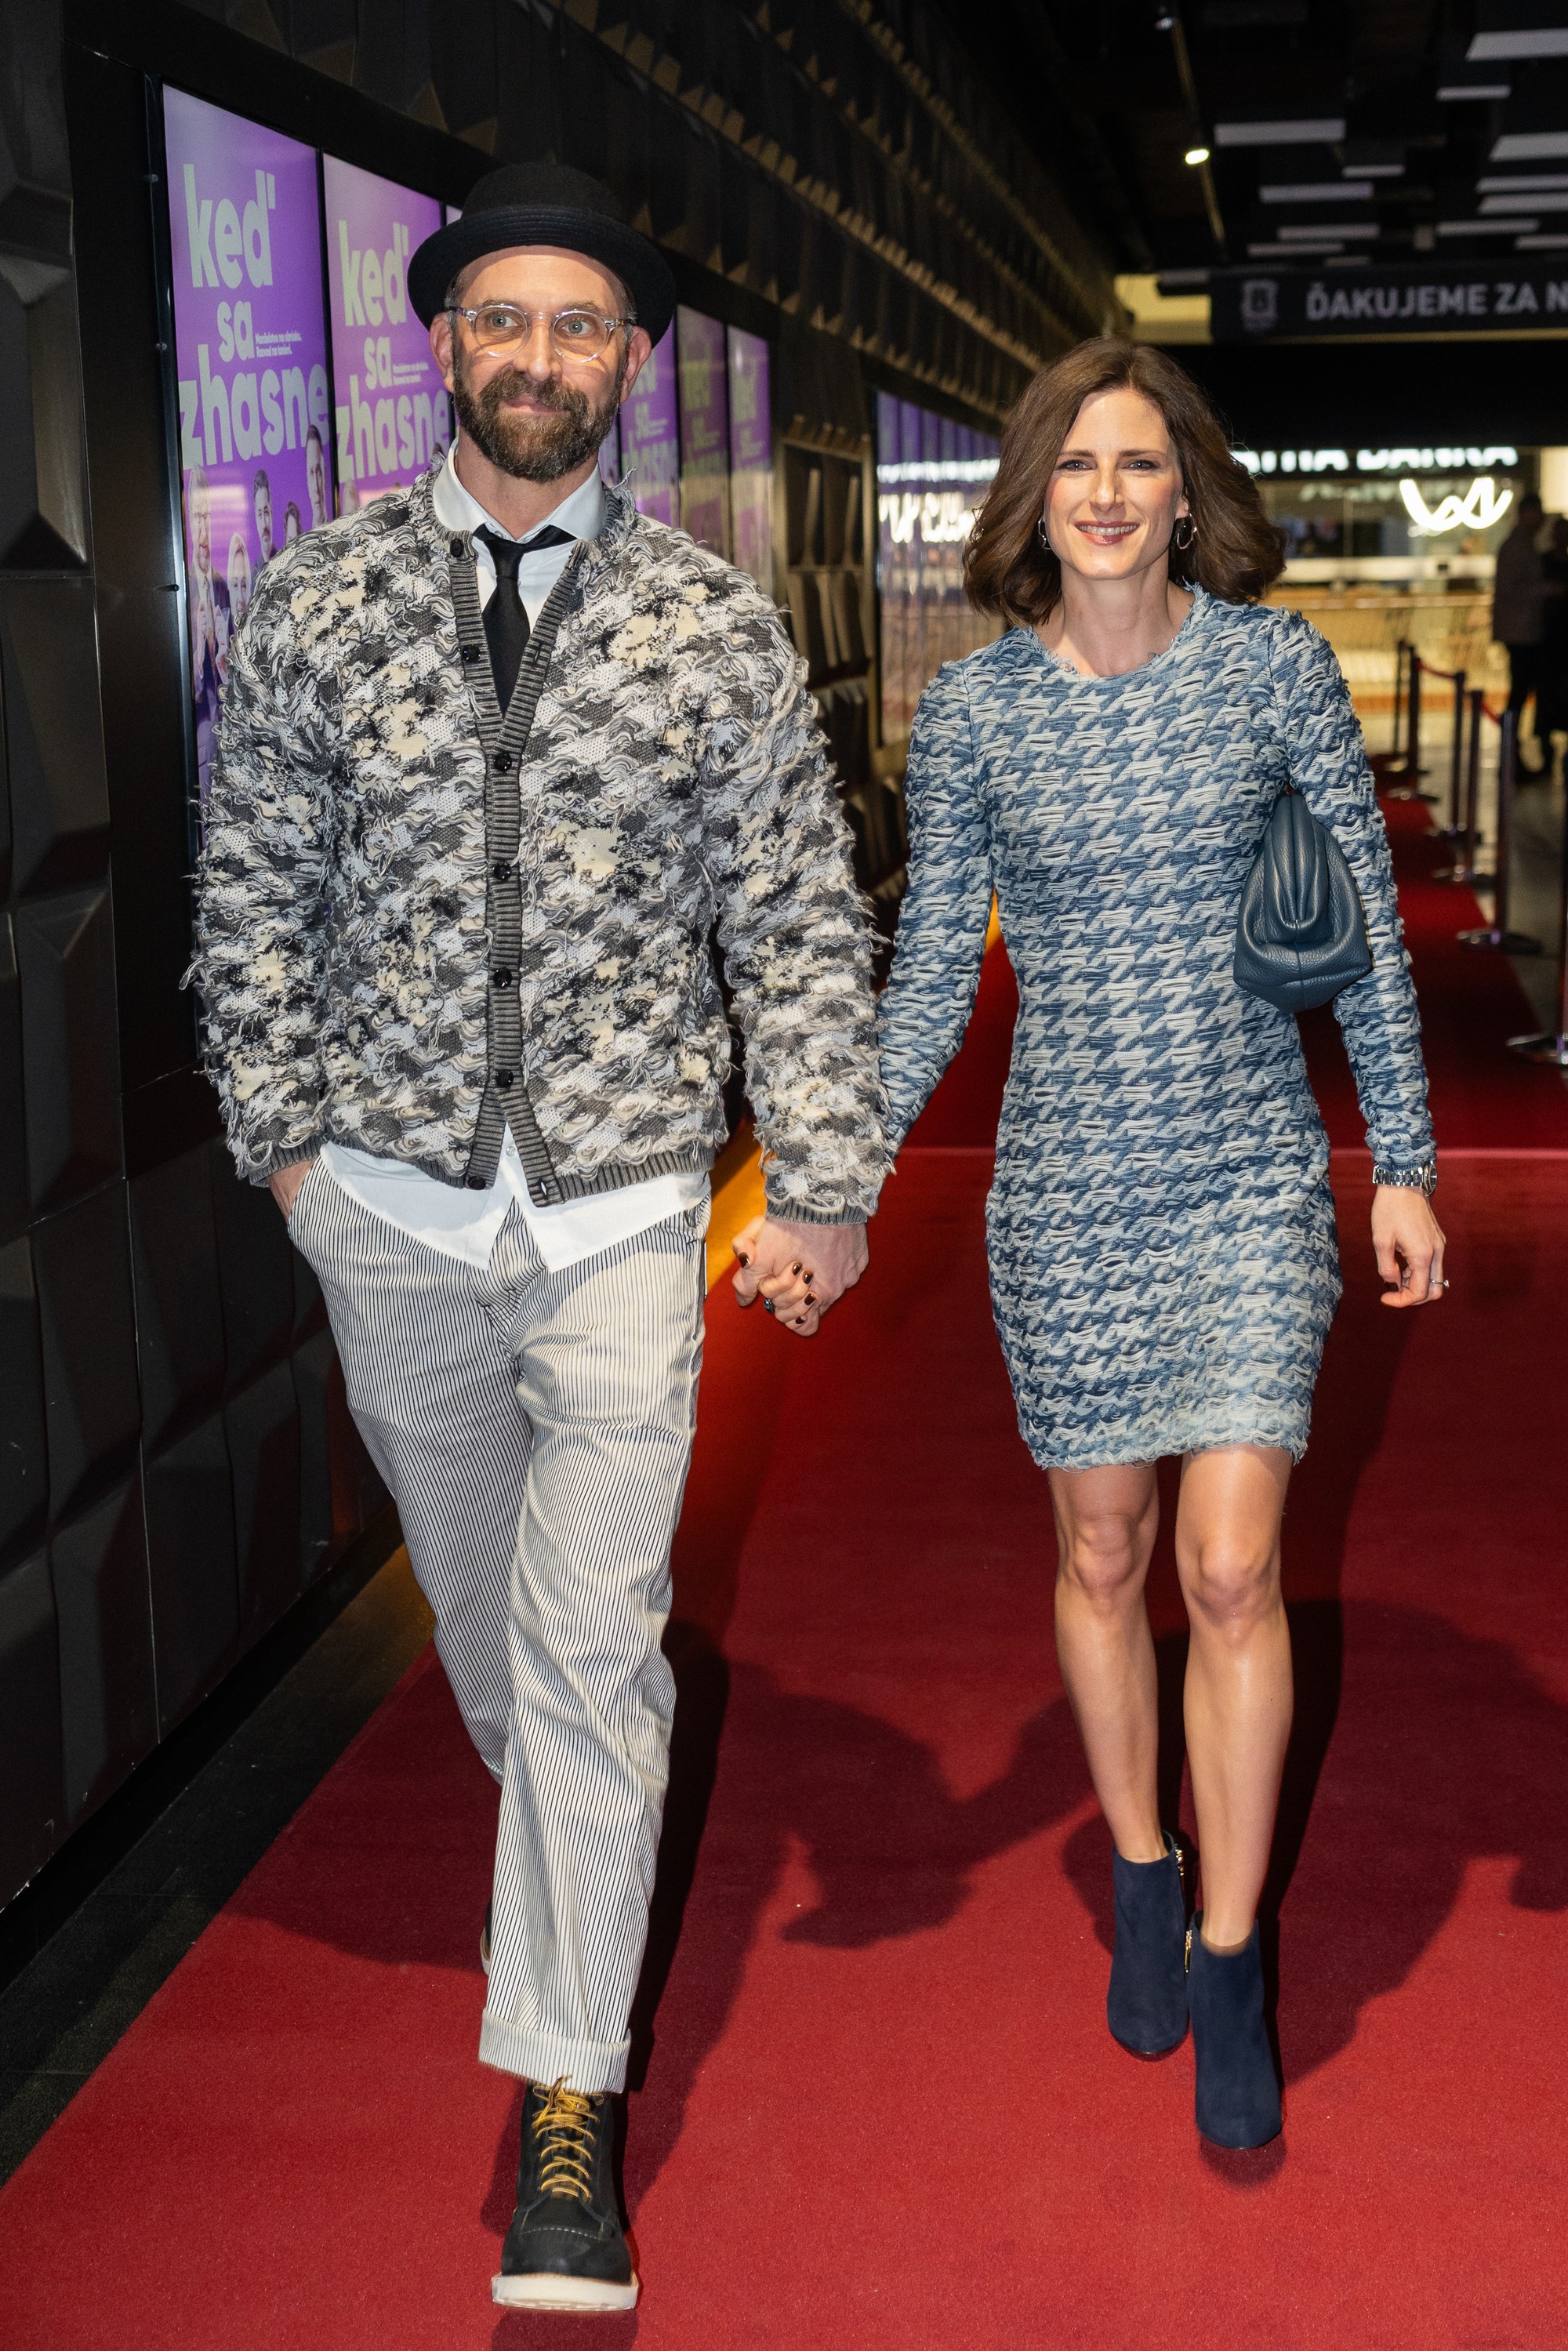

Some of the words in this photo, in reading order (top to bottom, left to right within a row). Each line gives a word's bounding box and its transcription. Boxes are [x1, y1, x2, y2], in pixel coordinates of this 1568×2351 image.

[183, 164, 275, 288] keď
[339, 220, 408, 327] keď
[217, 301, 254, 362] sa
[1306, 281, 1488, 320] ĎAKUJEME
[1494, 282, 1538, 314] ZA
[179, 344, 329, 470] zhasne
[364, 337, 392, 390] sa
[336, 374, 450, 483] zhasne
